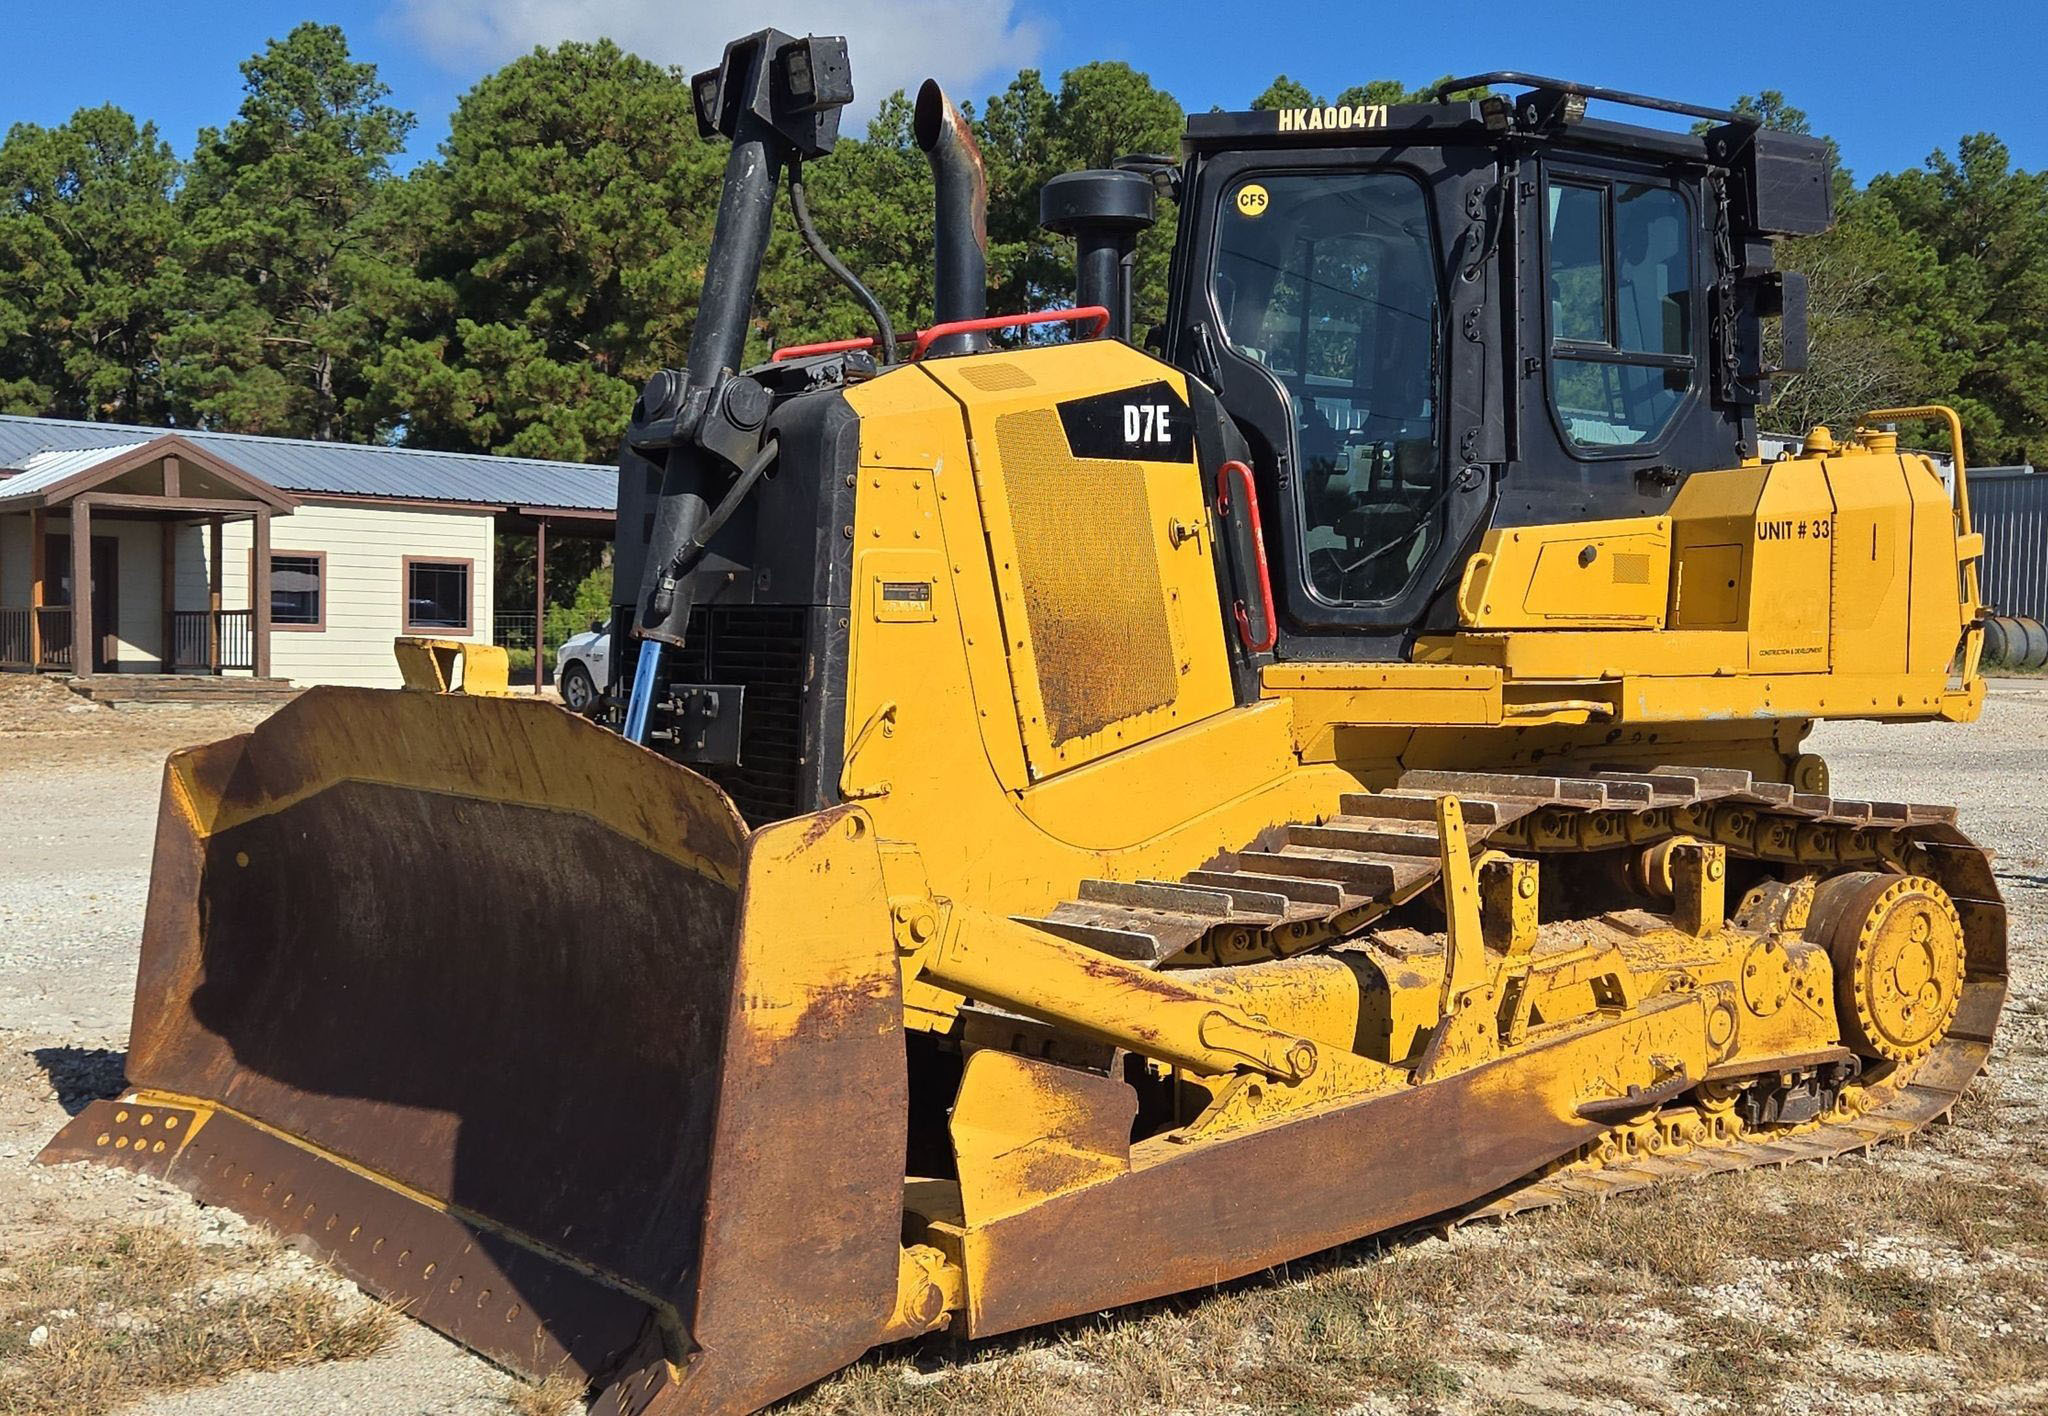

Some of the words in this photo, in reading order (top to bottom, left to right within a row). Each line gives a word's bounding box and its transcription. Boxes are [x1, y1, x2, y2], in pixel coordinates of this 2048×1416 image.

[1279, 105, 1387, 131] HKA00471
[1240, 194, 1265, 206] CFS
[1124, 405, 1171, 442] D7E
[1757, 521, 1793, 540] UNIT
[1797, 520, 1807, 540] #
[1812, 520, 1830, 539] 33
